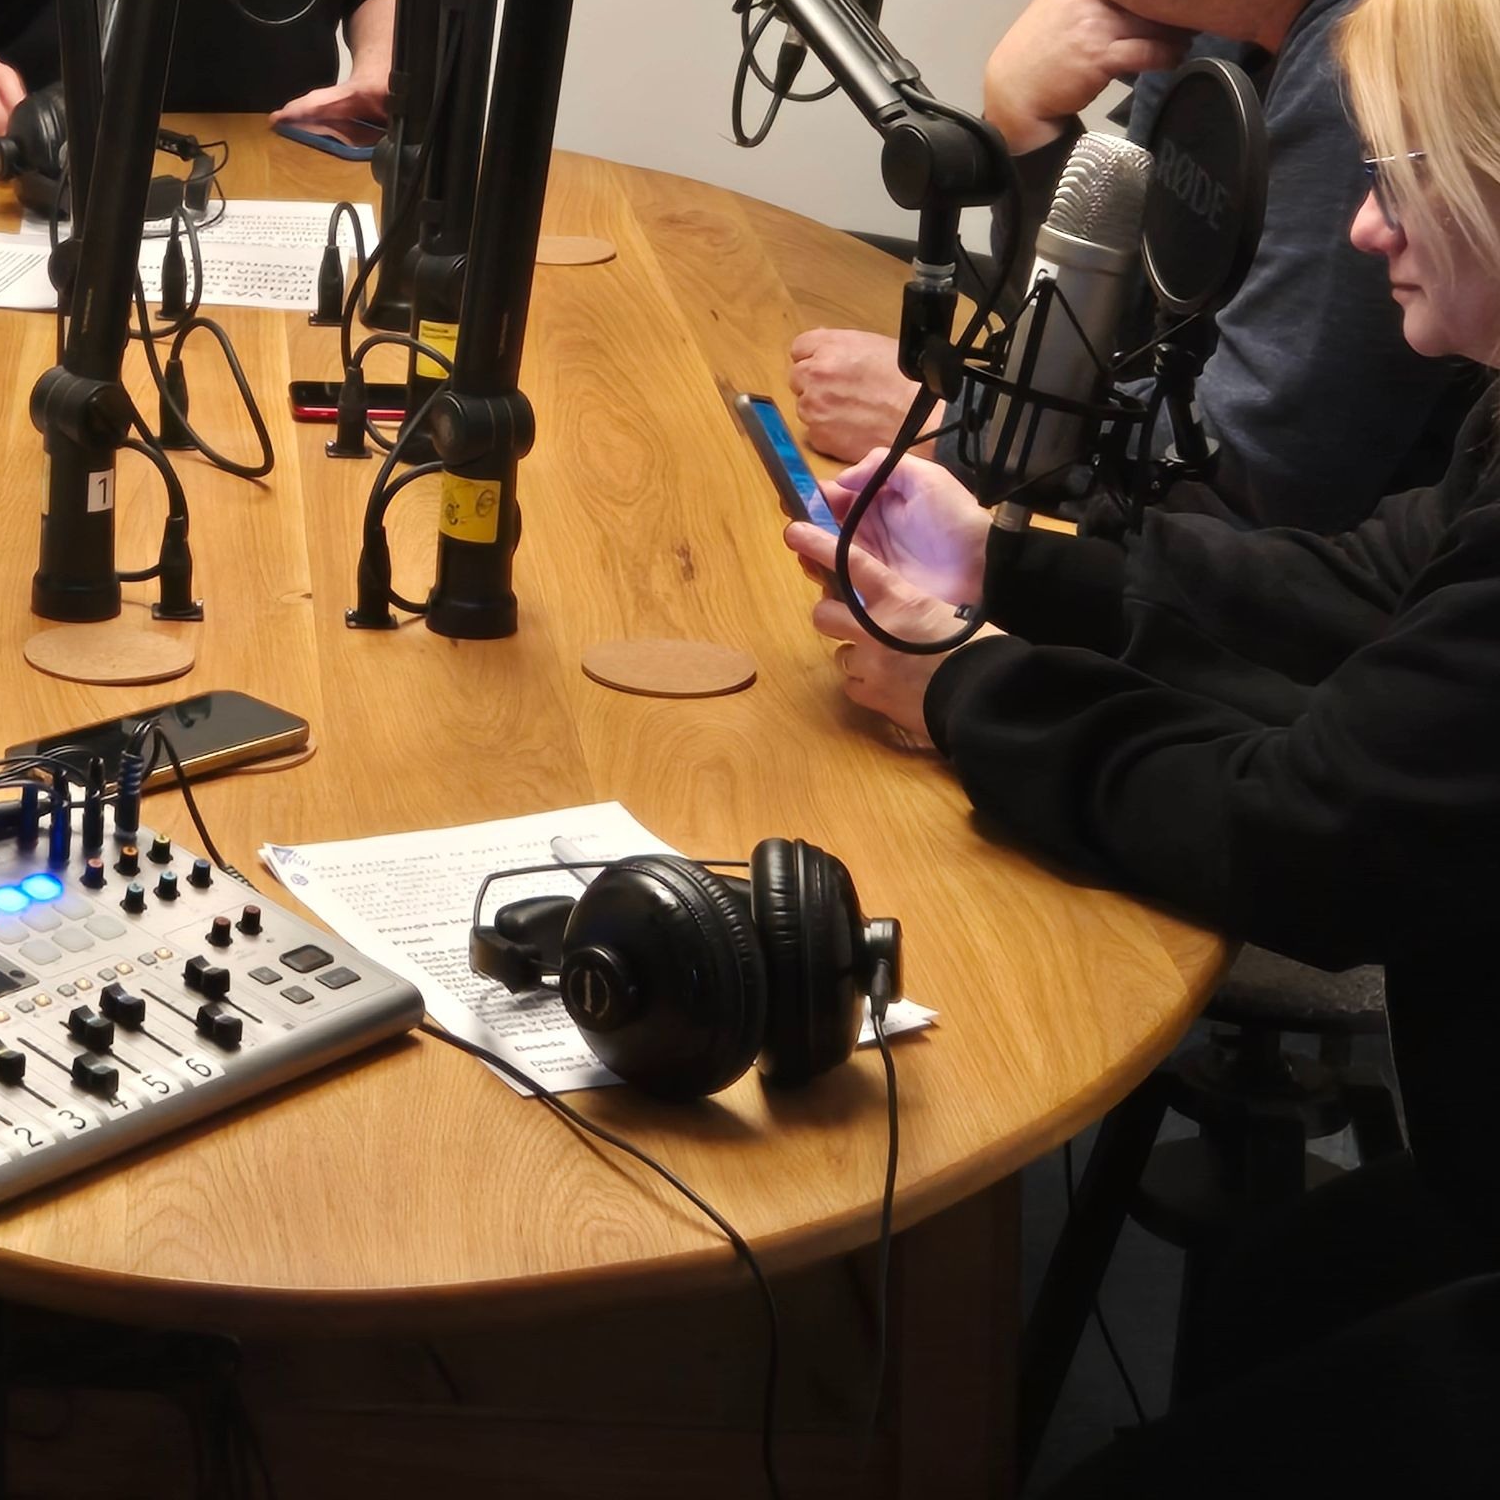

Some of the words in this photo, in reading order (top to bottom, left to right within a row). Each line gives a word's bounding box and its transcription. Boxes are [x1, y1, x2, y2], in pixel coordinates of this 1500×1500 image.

[1156, 137, 1230, 231] RØDE
[98, 476, 108, 505] 1
[13, 1127, 44, 1148] 2
[57, 1109, 87, 1130] 3
[108, 1096, 130, 1111] 4
[141, 1074, 170, 1095] 5
[185, 1057, 213, 1078] 6
